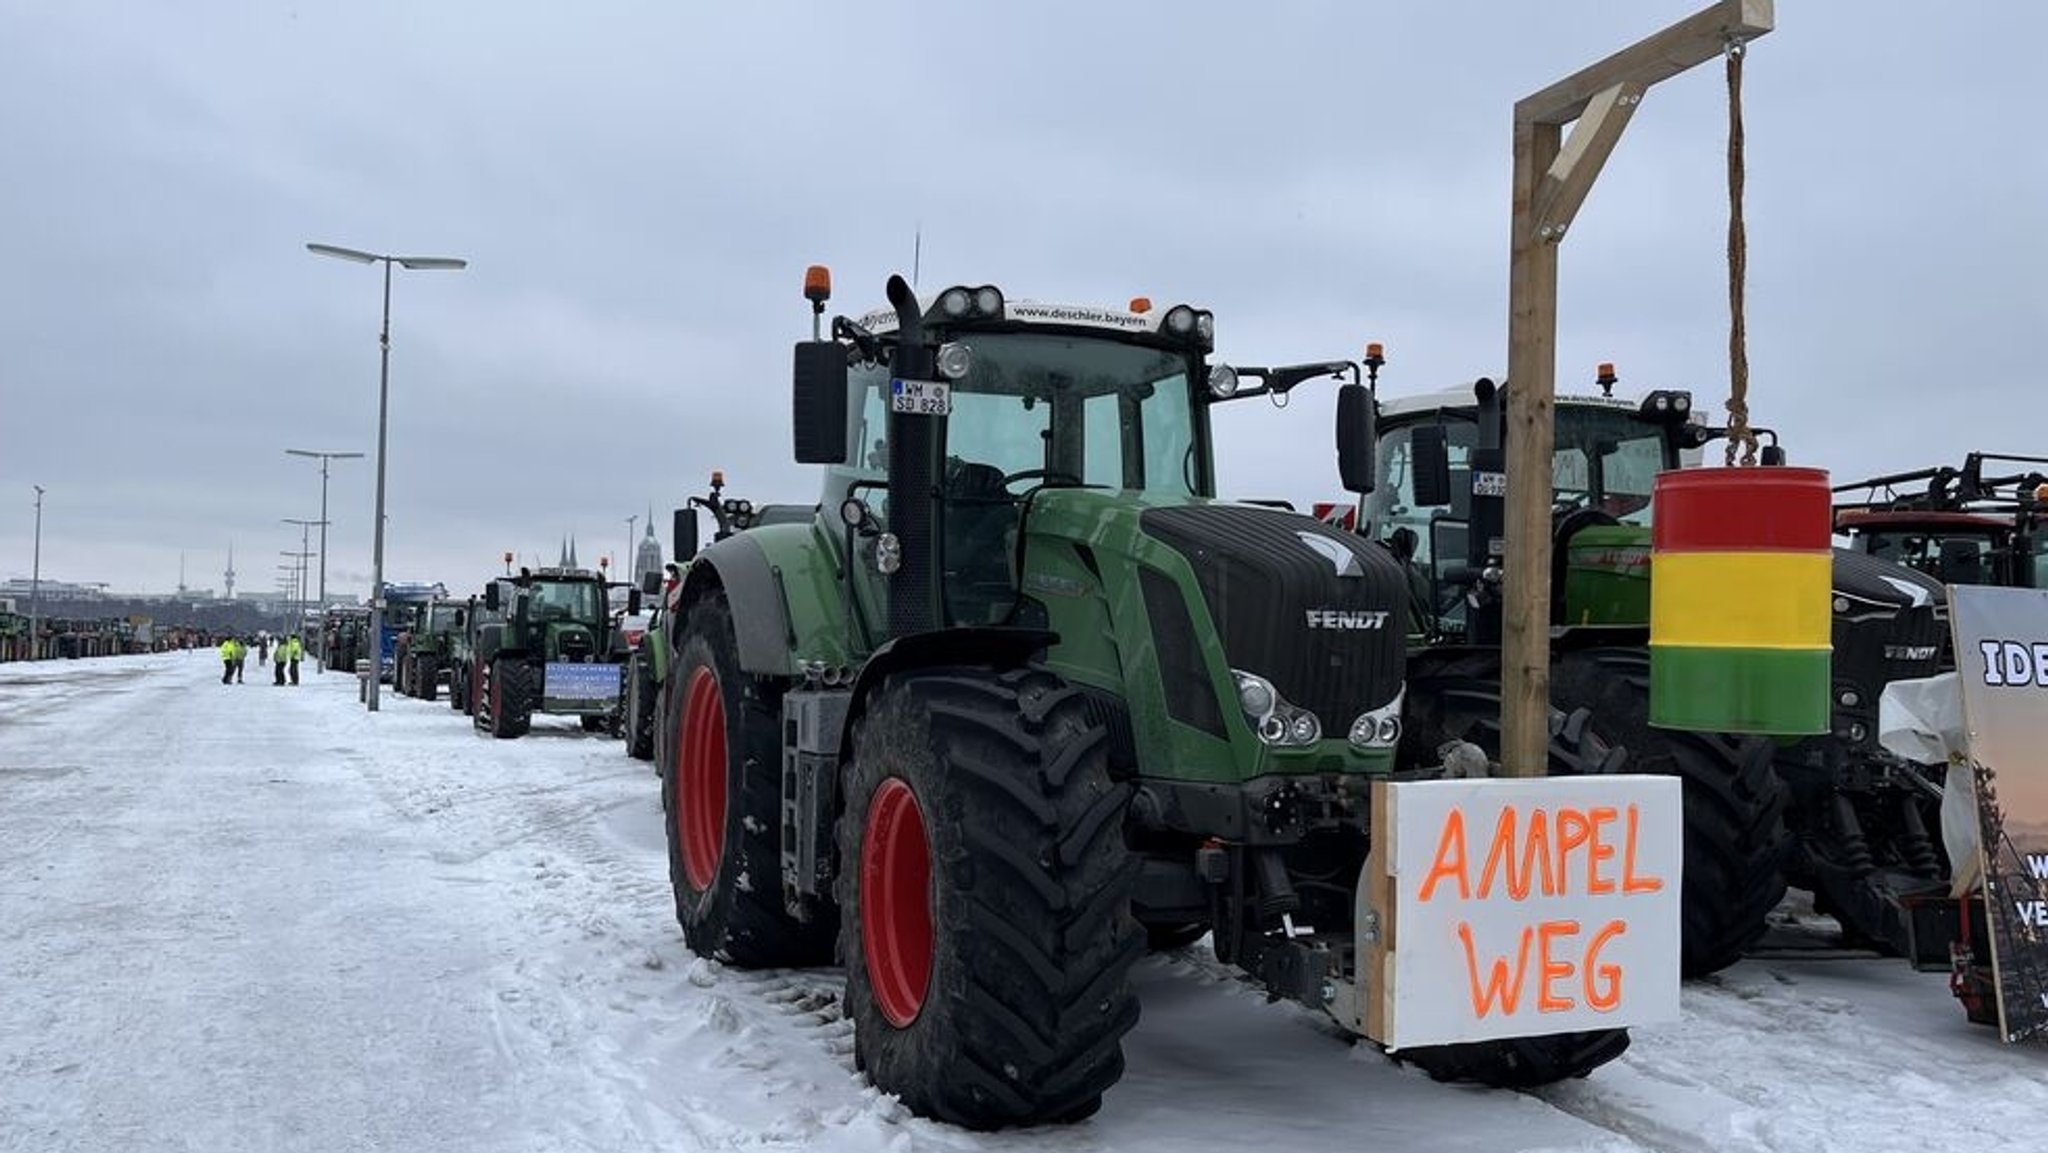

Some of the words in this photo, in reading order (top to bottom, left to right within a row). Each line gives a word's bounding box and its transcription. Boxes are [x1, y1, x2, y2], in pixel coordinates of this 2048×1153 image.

[1013, 307, 1147, 326] www.deschler.bayern
[905, 383, 923, 397] WM
[920, 398, 946, 413] 828
[1305, 610, 1389, 630] FENDT
[1417, 802, 1665, 902] AMPEL
[1457, 919, 1627, 1020] WEG
